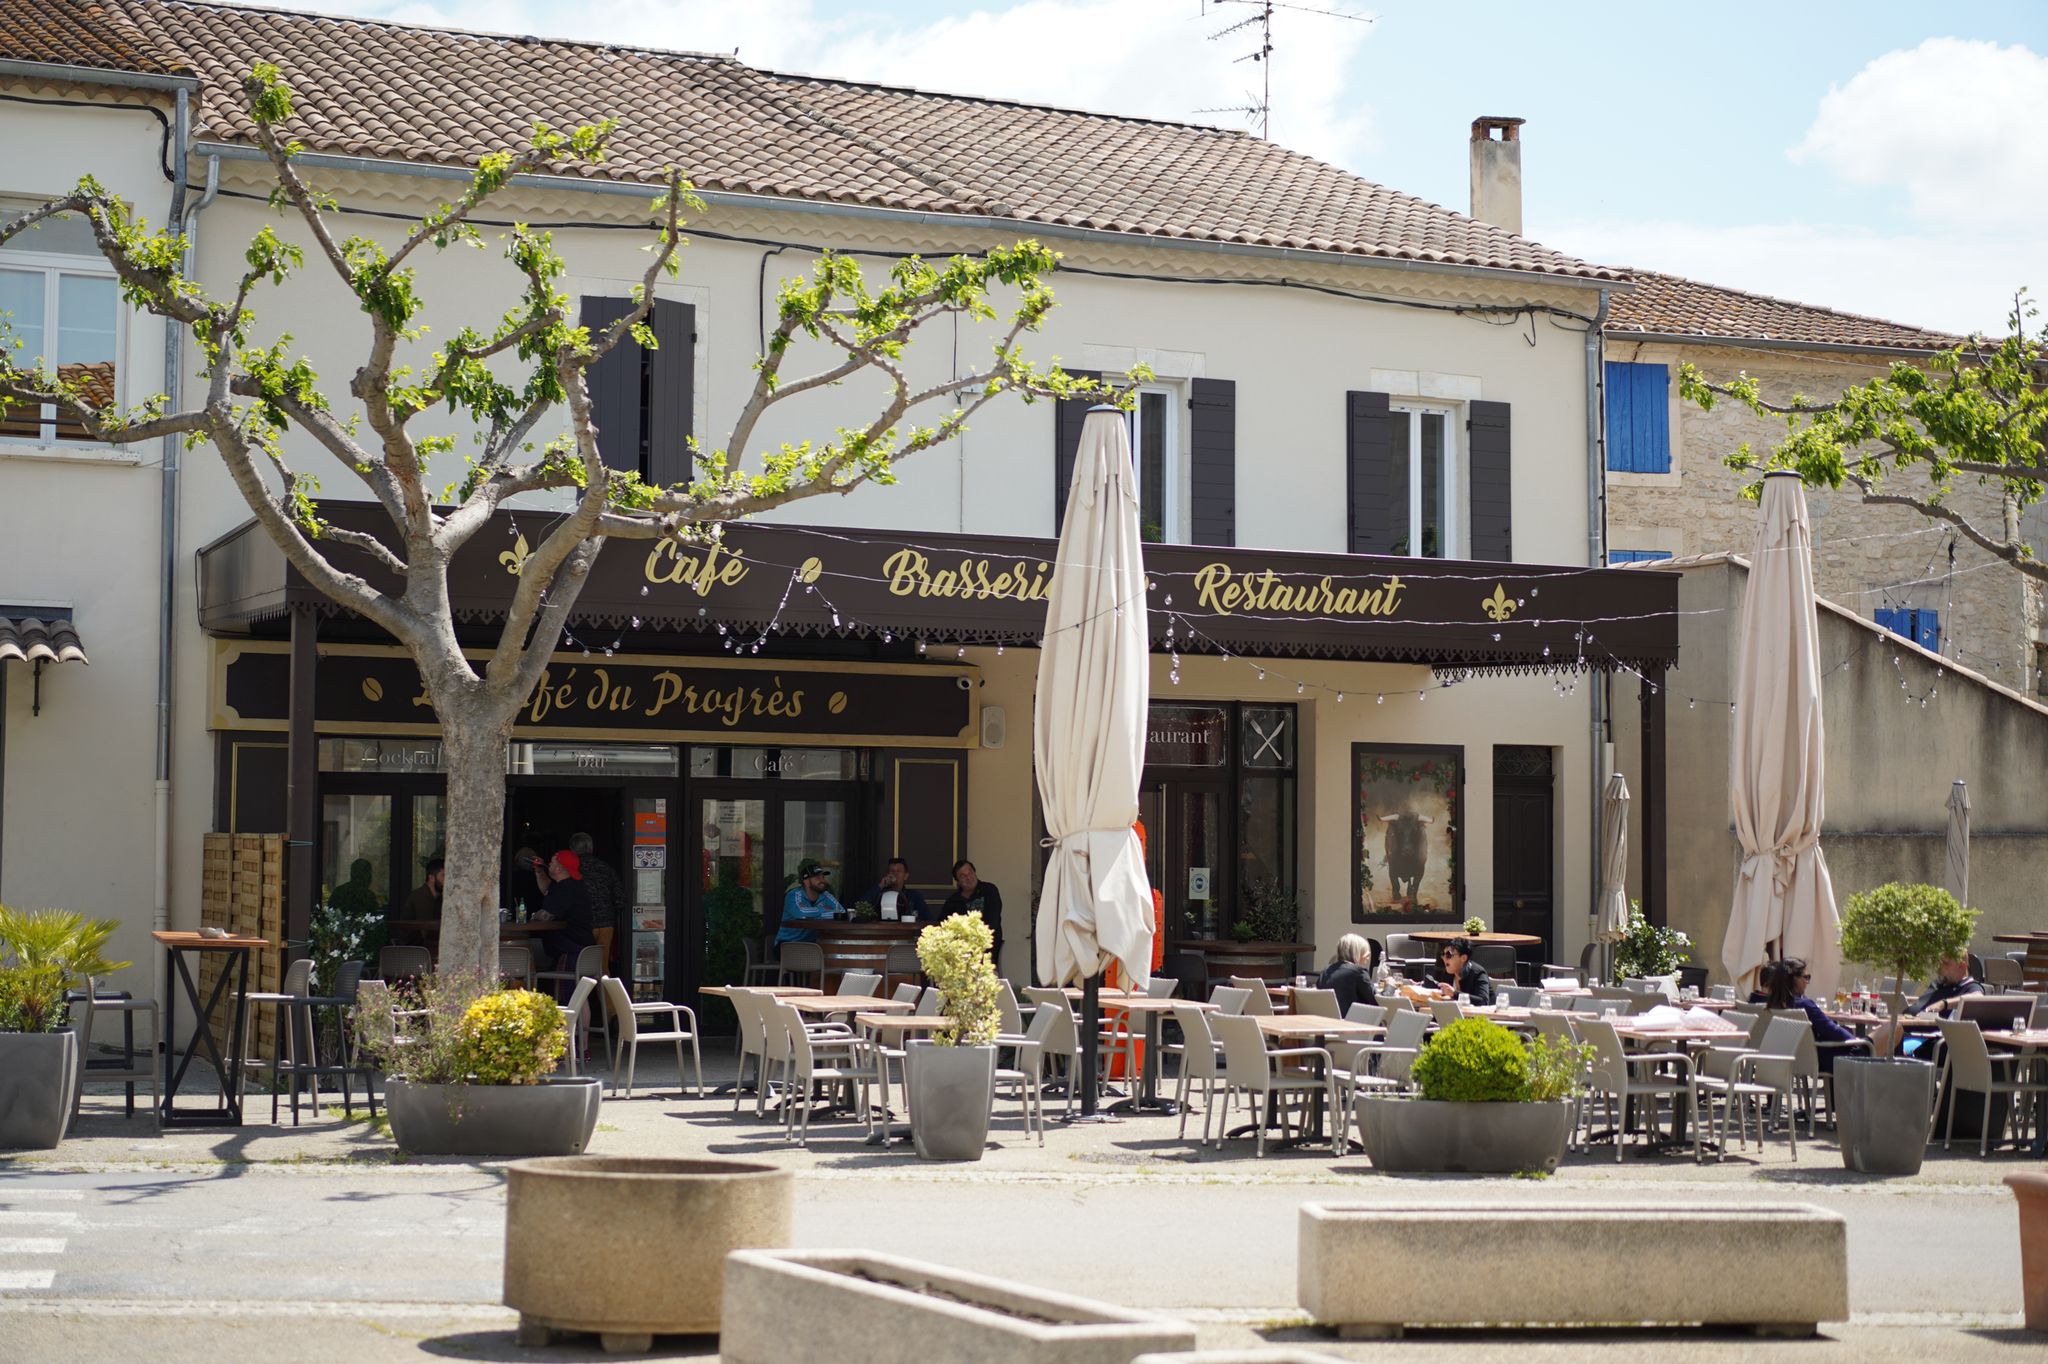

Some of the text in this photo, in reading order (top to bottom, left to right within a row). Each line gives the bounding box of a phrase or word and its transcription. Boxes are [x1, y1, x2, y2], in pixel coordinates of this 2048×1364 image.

[645, 537, 749, 597] Café
[1194, 562, 1406, 616] Restaurant
[586, 669, 636, 711] du
[645, 672, 805, 726] Progrès
[754, 752, 793, 772] Café
